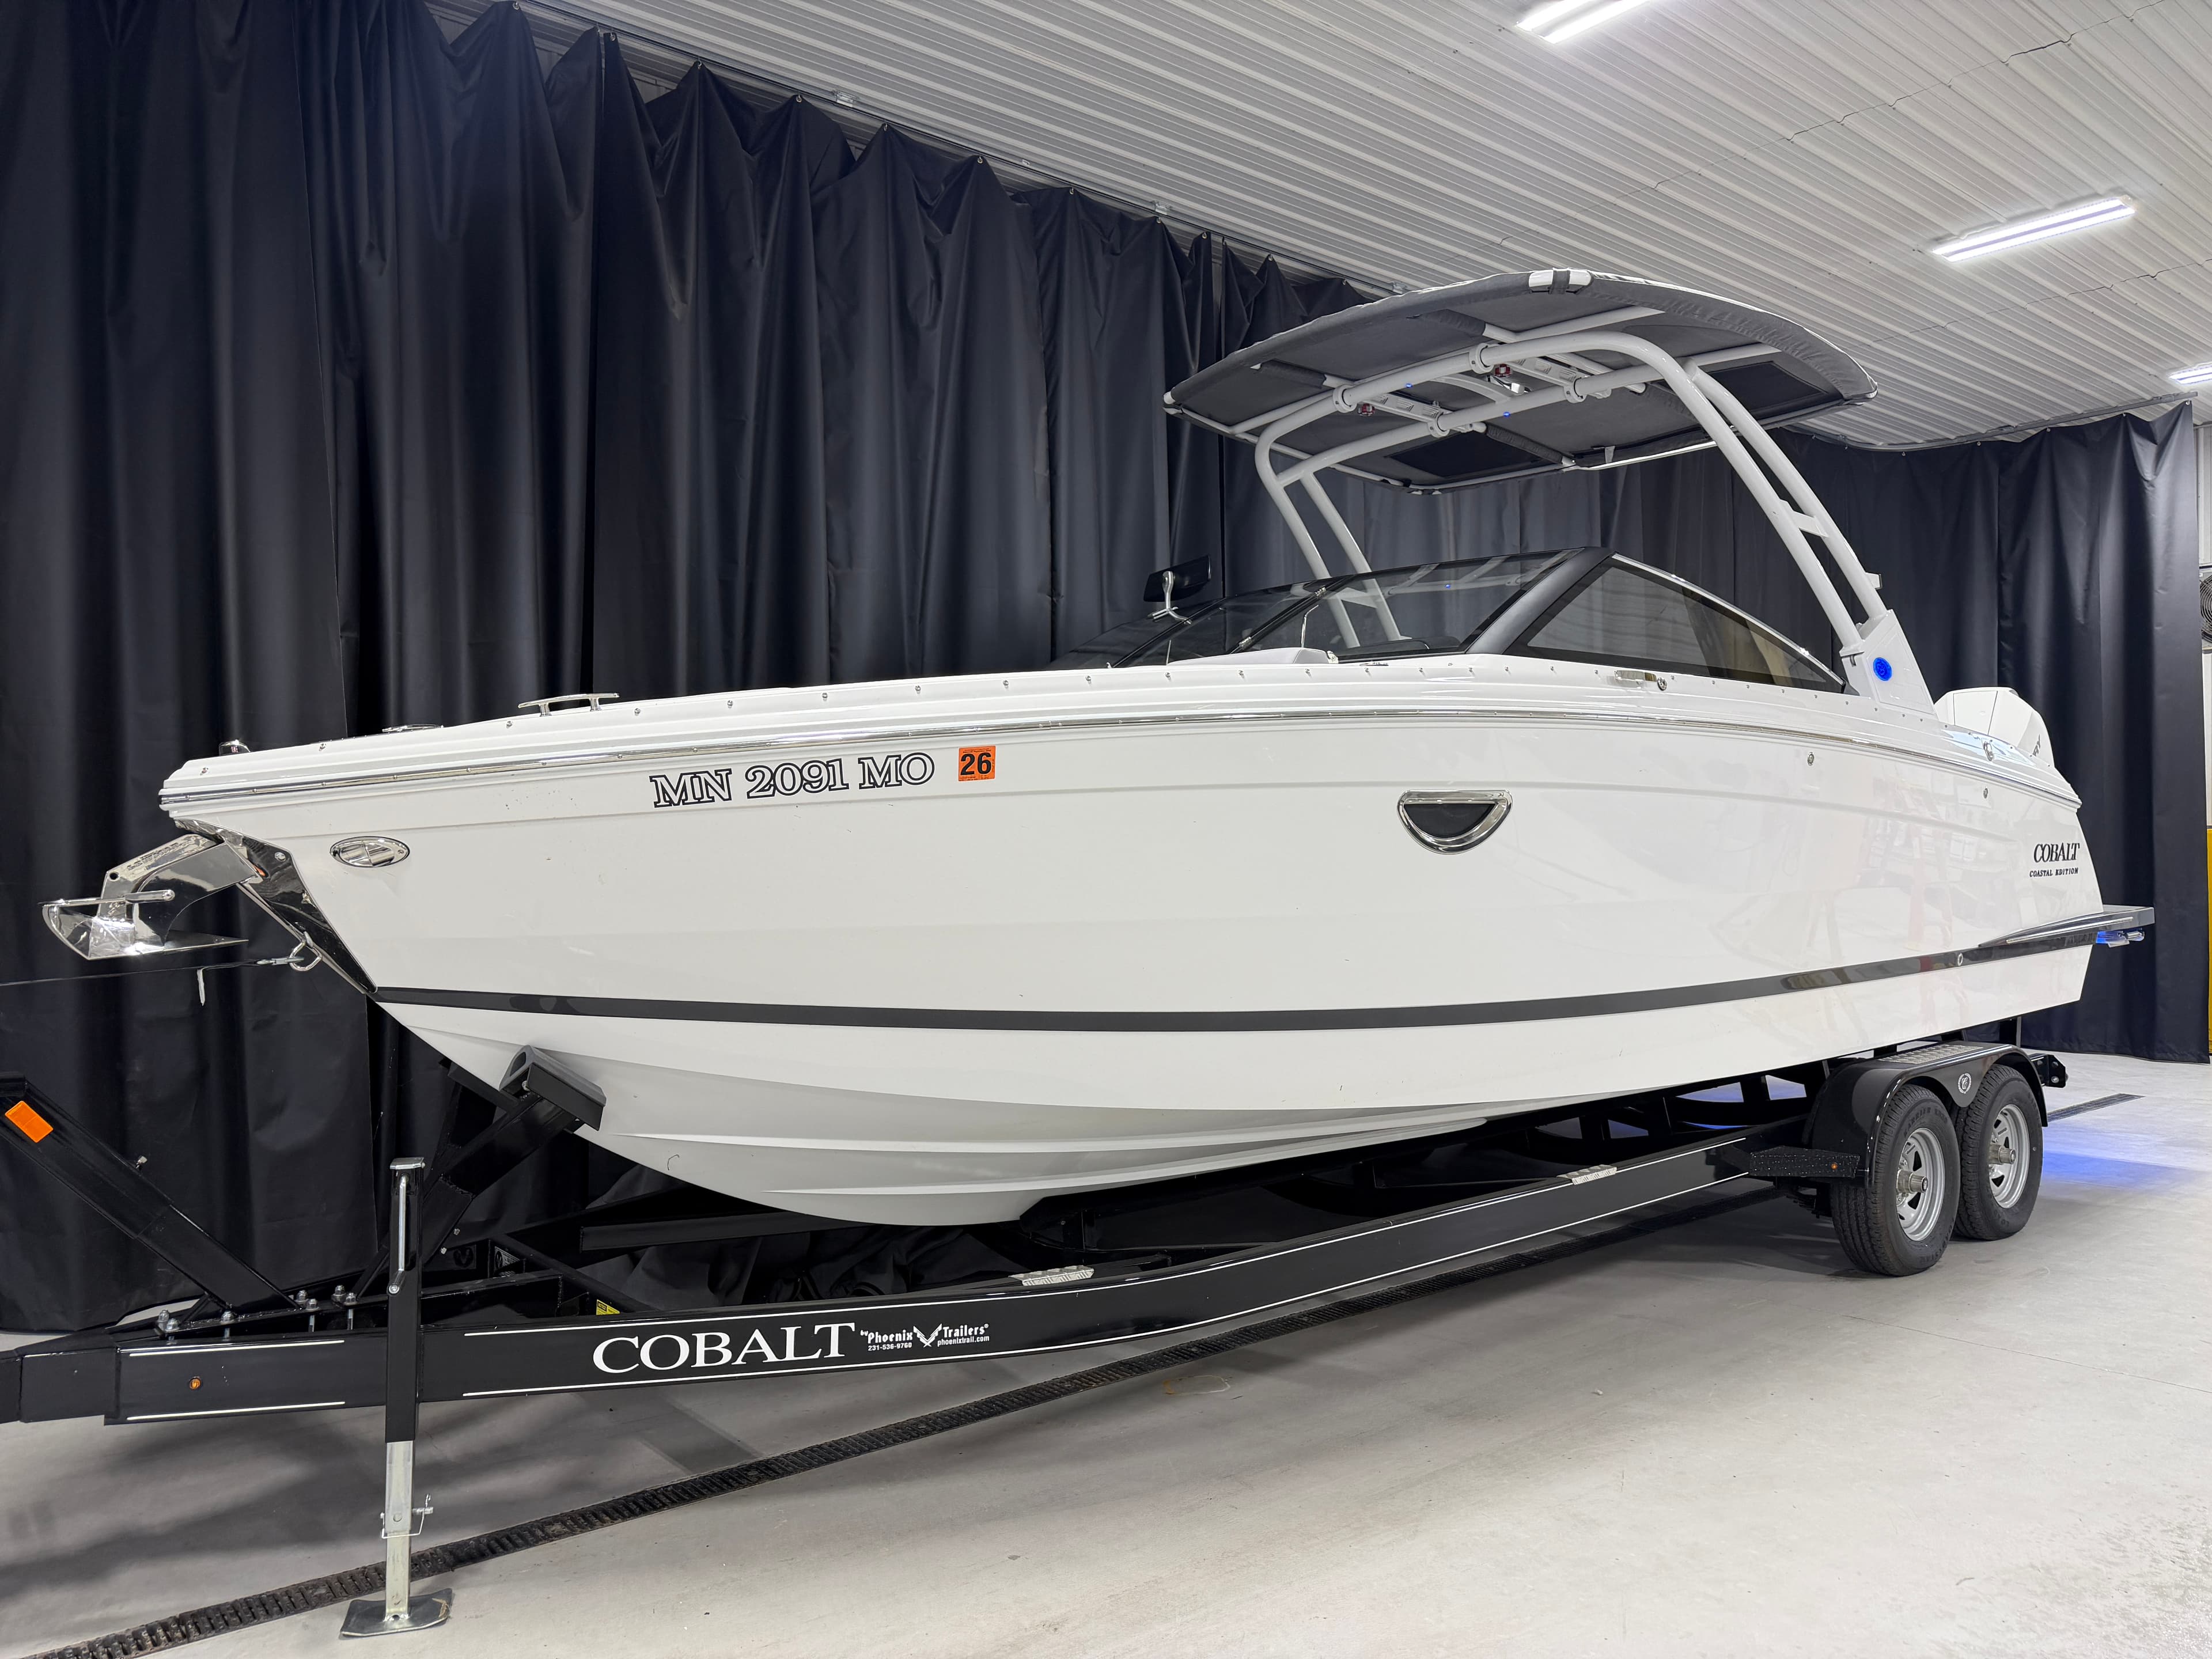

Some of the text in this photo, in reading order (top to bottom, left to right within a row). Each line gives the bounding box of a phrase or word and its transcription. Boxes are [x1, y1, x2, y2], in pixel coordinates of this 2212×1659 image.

[960, 752, 992, 776] 26
[649, 752, 935, 808] MN 2091 MO
[2033, 842, 2080, 863] COBALT
[2029, 867, 2078, 877] COASTAL EDITION
[868, 1330, 913, 1344] Phoenix
[937, 1335, 990, 1347] phoenixtrail.com
[593, 1323, 855, 1373] COBALT
